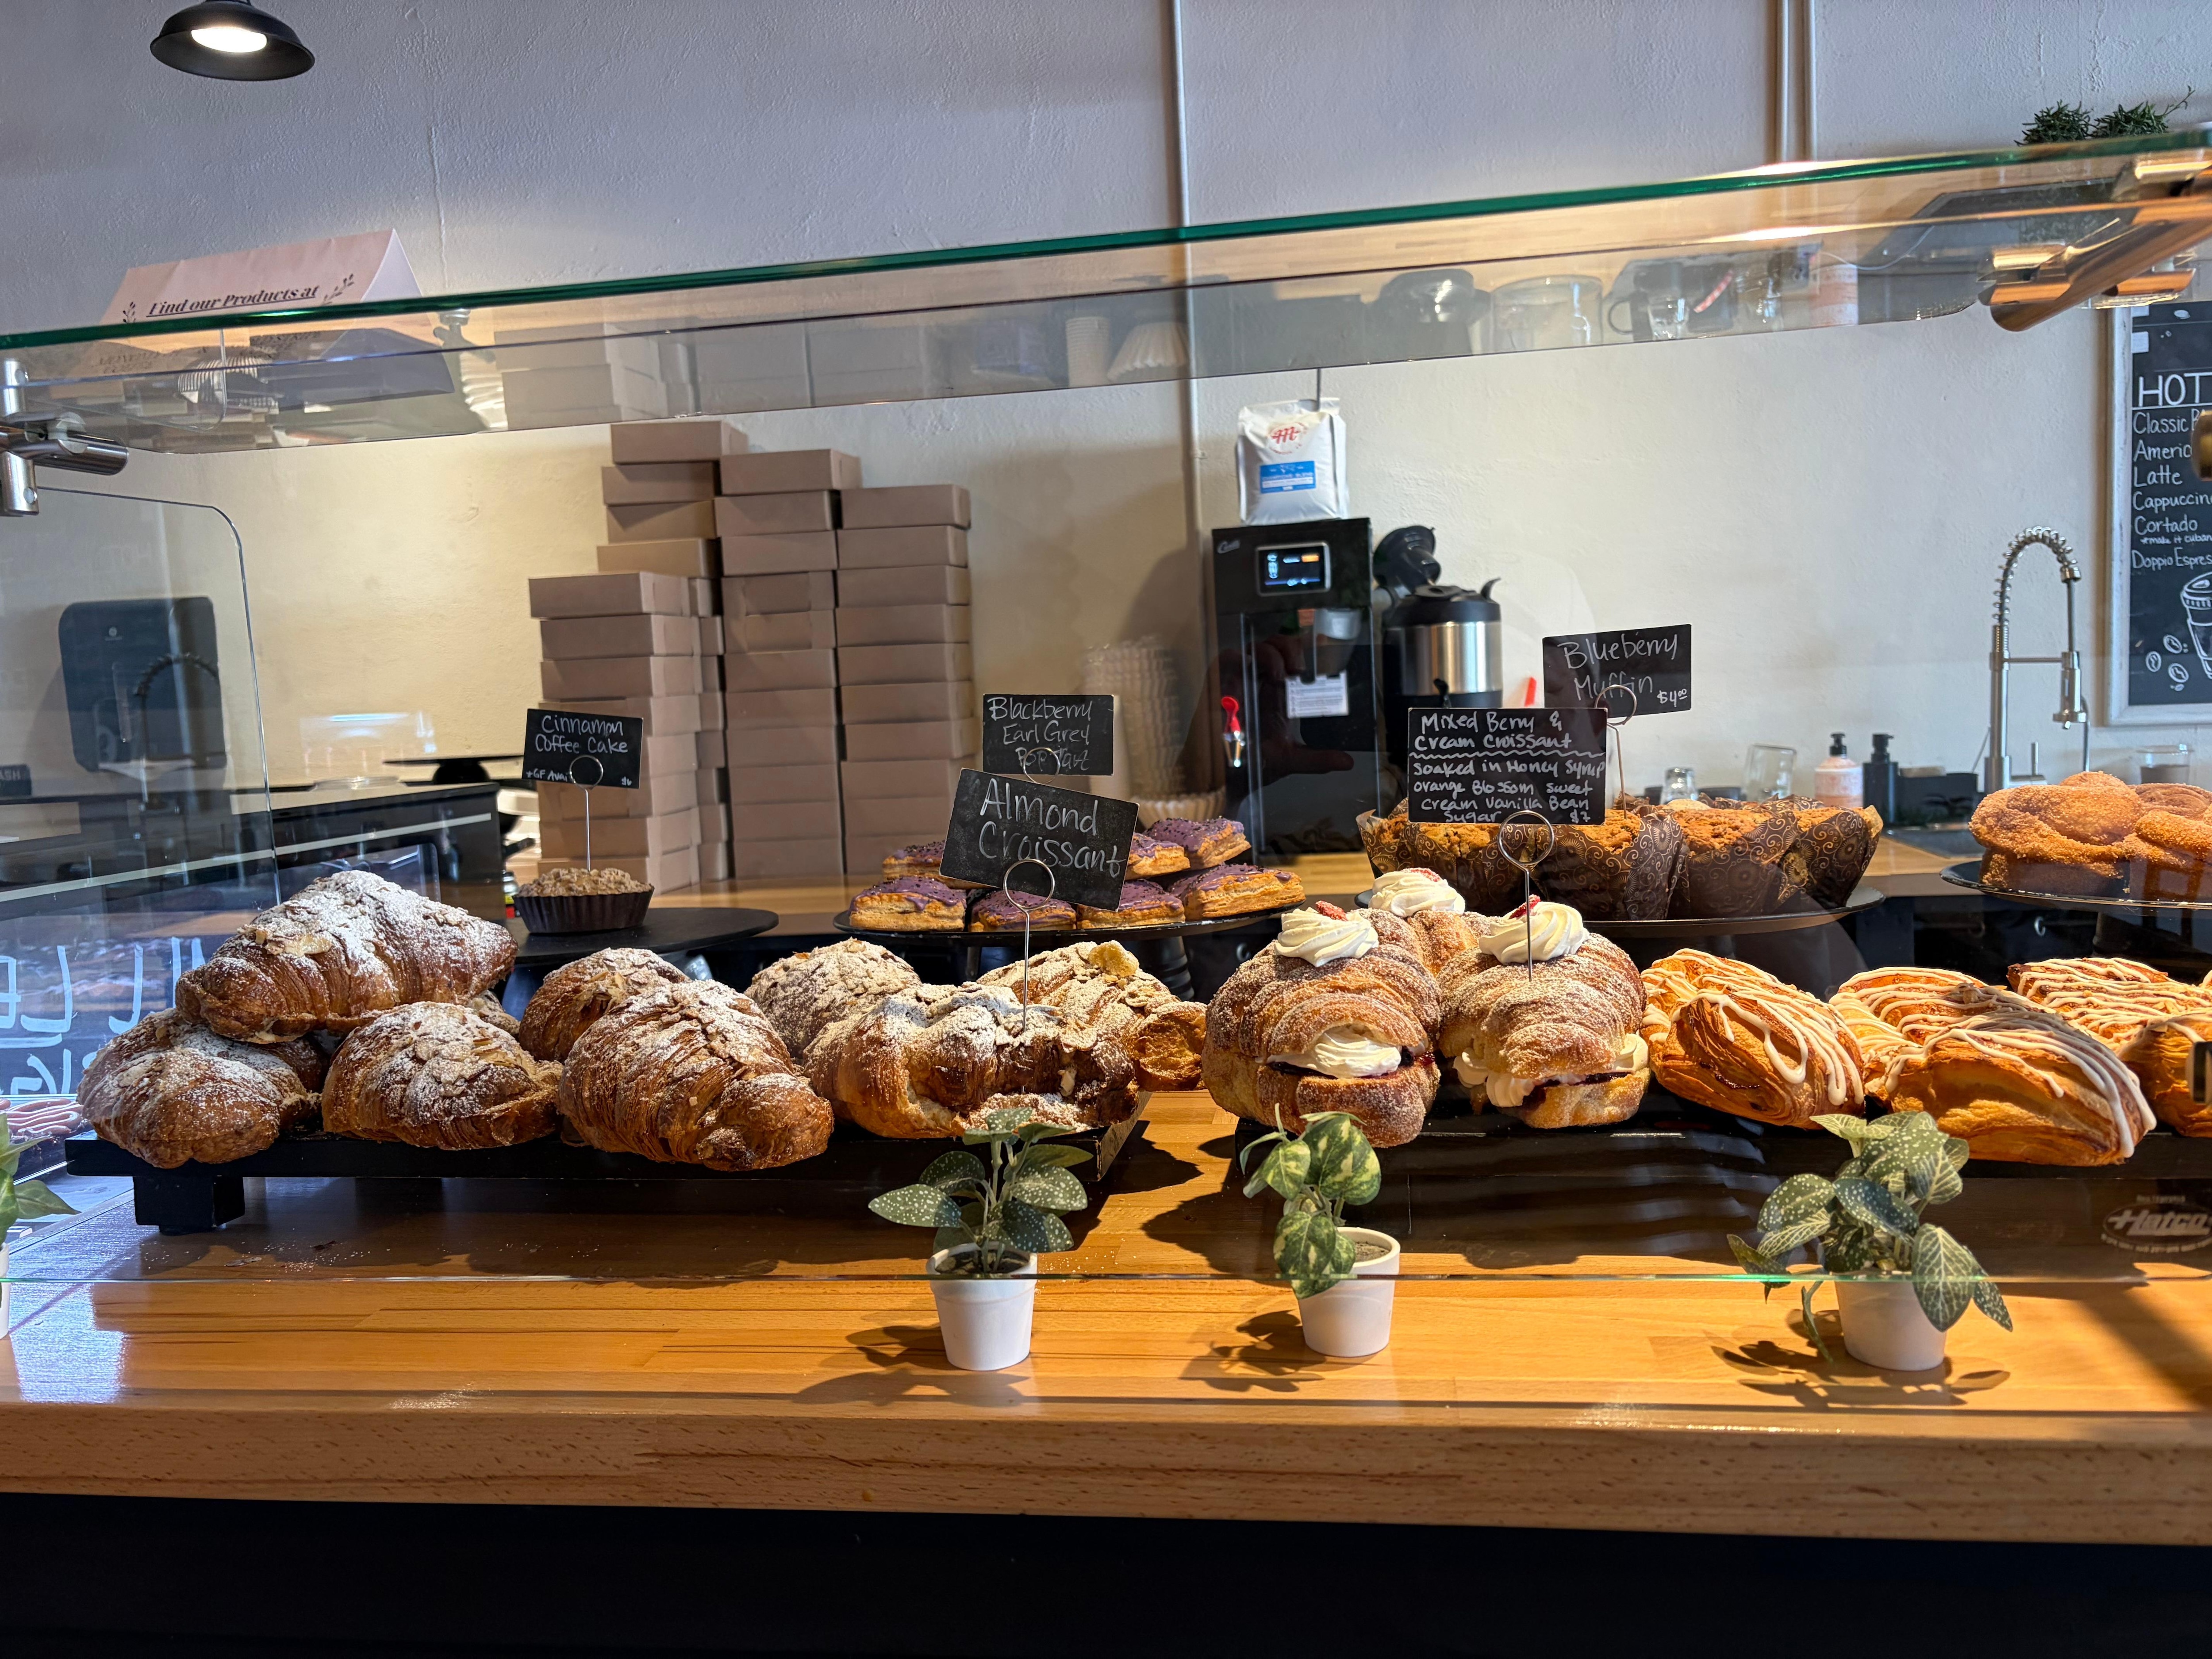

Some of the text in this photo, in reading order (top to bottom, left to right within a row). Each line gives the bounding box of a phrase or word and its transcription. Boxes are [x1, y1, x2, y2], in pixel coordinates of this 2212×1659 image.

[149, 285, 320, 315] Find our Products at
[2138, 372, 2212, 407] HOT
[2133, 411, 2189, 434] Classic
[2133, 438, 2192, 462] Americ
[2134, 465, 2183, 487] Latte
[2134, 514, 2198, 535] Cortado
[2131, 549, 2173, 571] Doppio
[1557, 633, 1678, 669] Blueberry
[1574, 671, 1653, 701] Muffin
[987, 697, 1093, 721] Blackberry
[541, 714, 623, 736] Cinnamon
[1003, 719, 1090, 745] Earl Grey
[1421, 710, 1563, 734] Mixed Berry &
[535, 733, 629, 754] Coffee Cake
[1482, 760, 1502, 773] in
[1507, 760, 1558, 778] Honey
[979, 778, 1098, 836] Almond
[1549, 796, 1589, 811] Bean
[1569, 809, 1591, 824] $7
[979, 821, 1126, 878] Croissant
[2108, 1209, 2210, 1236] Hatco
